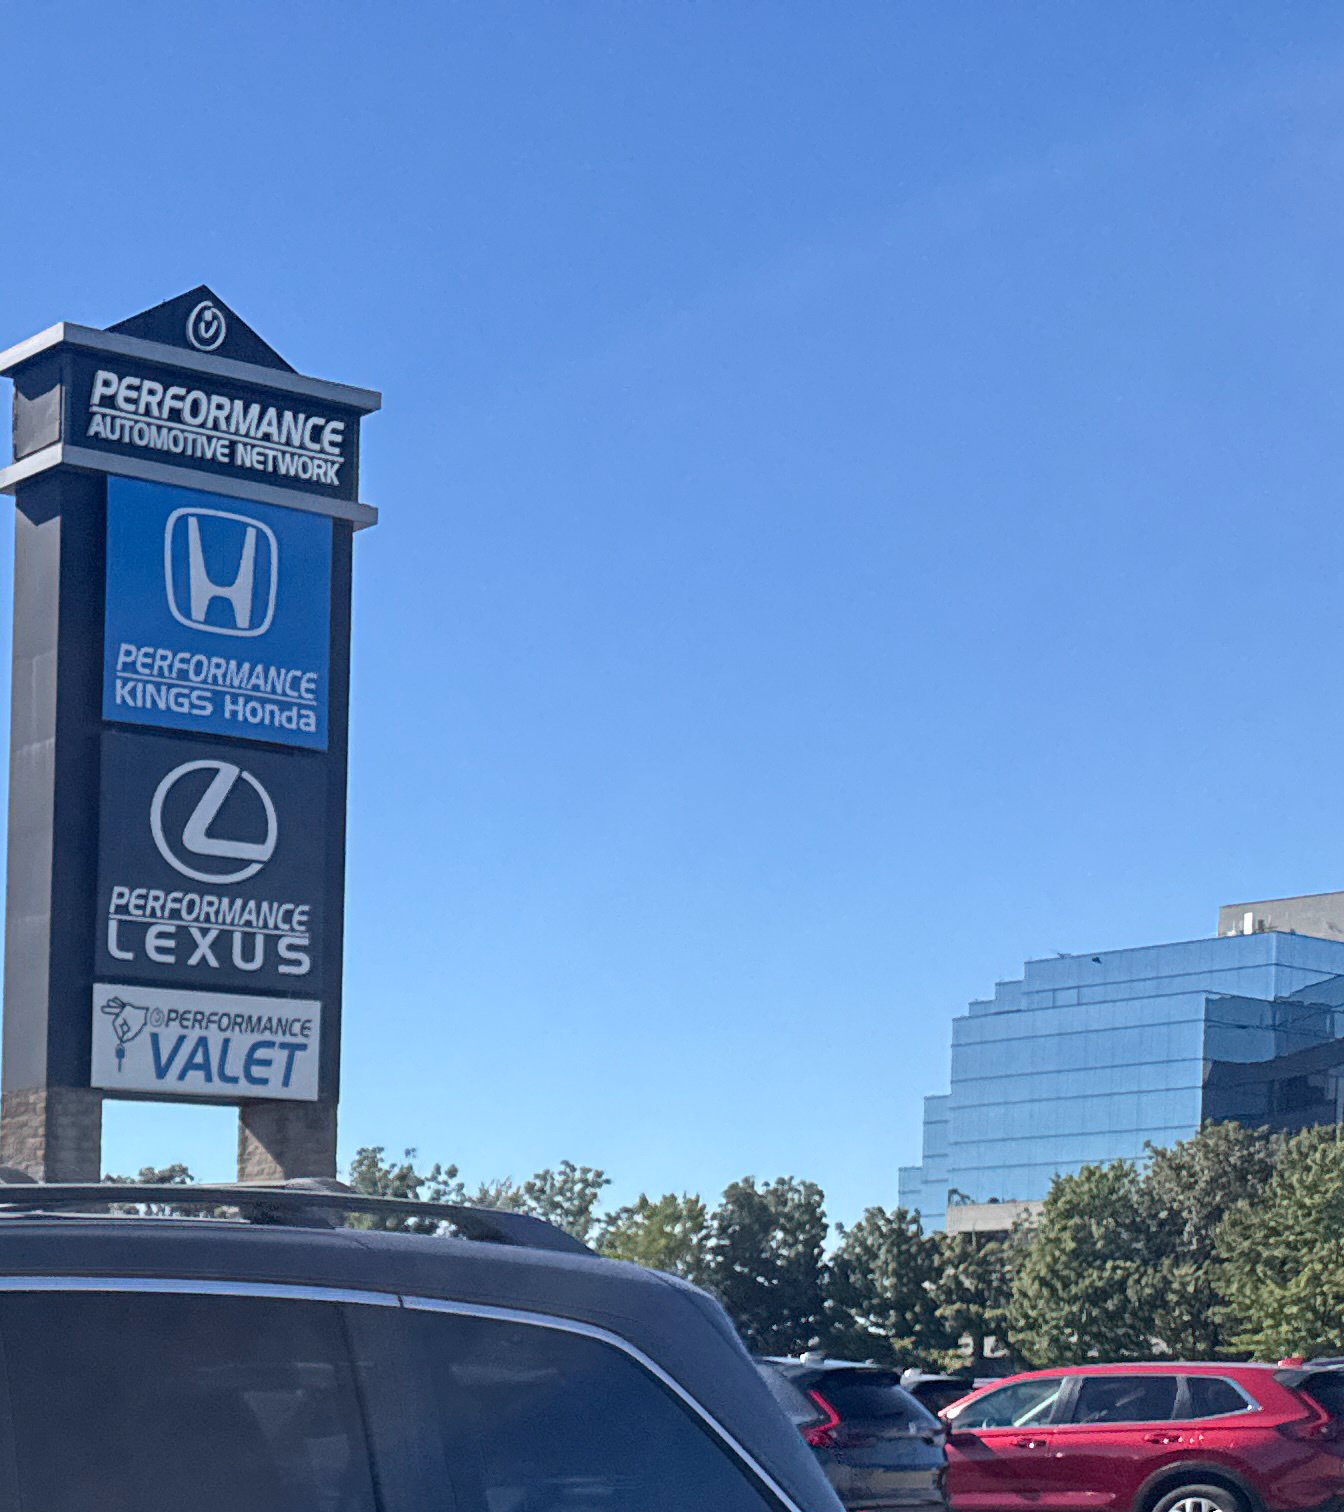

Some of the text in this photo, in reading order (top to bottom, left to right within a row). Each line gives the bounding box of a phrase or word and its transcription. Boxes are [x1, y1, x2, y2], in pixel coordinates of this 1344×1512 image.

[90, 369, 345, 455] PERFORMANCE
[86, 413, 341, 486] AUTOMOTIVE NETWORK
[116, 643, 318, 699] PERFORMANCE
[115, 678, 316, 733] KINGS Honda
[109, 886, 311, 932] PERFORMANCE
[107, 918, 311, 976] LEXUS
[165, 1008, 312, 1038] PERFORMANCE
[149, 1031, 308, 1088] VALET
